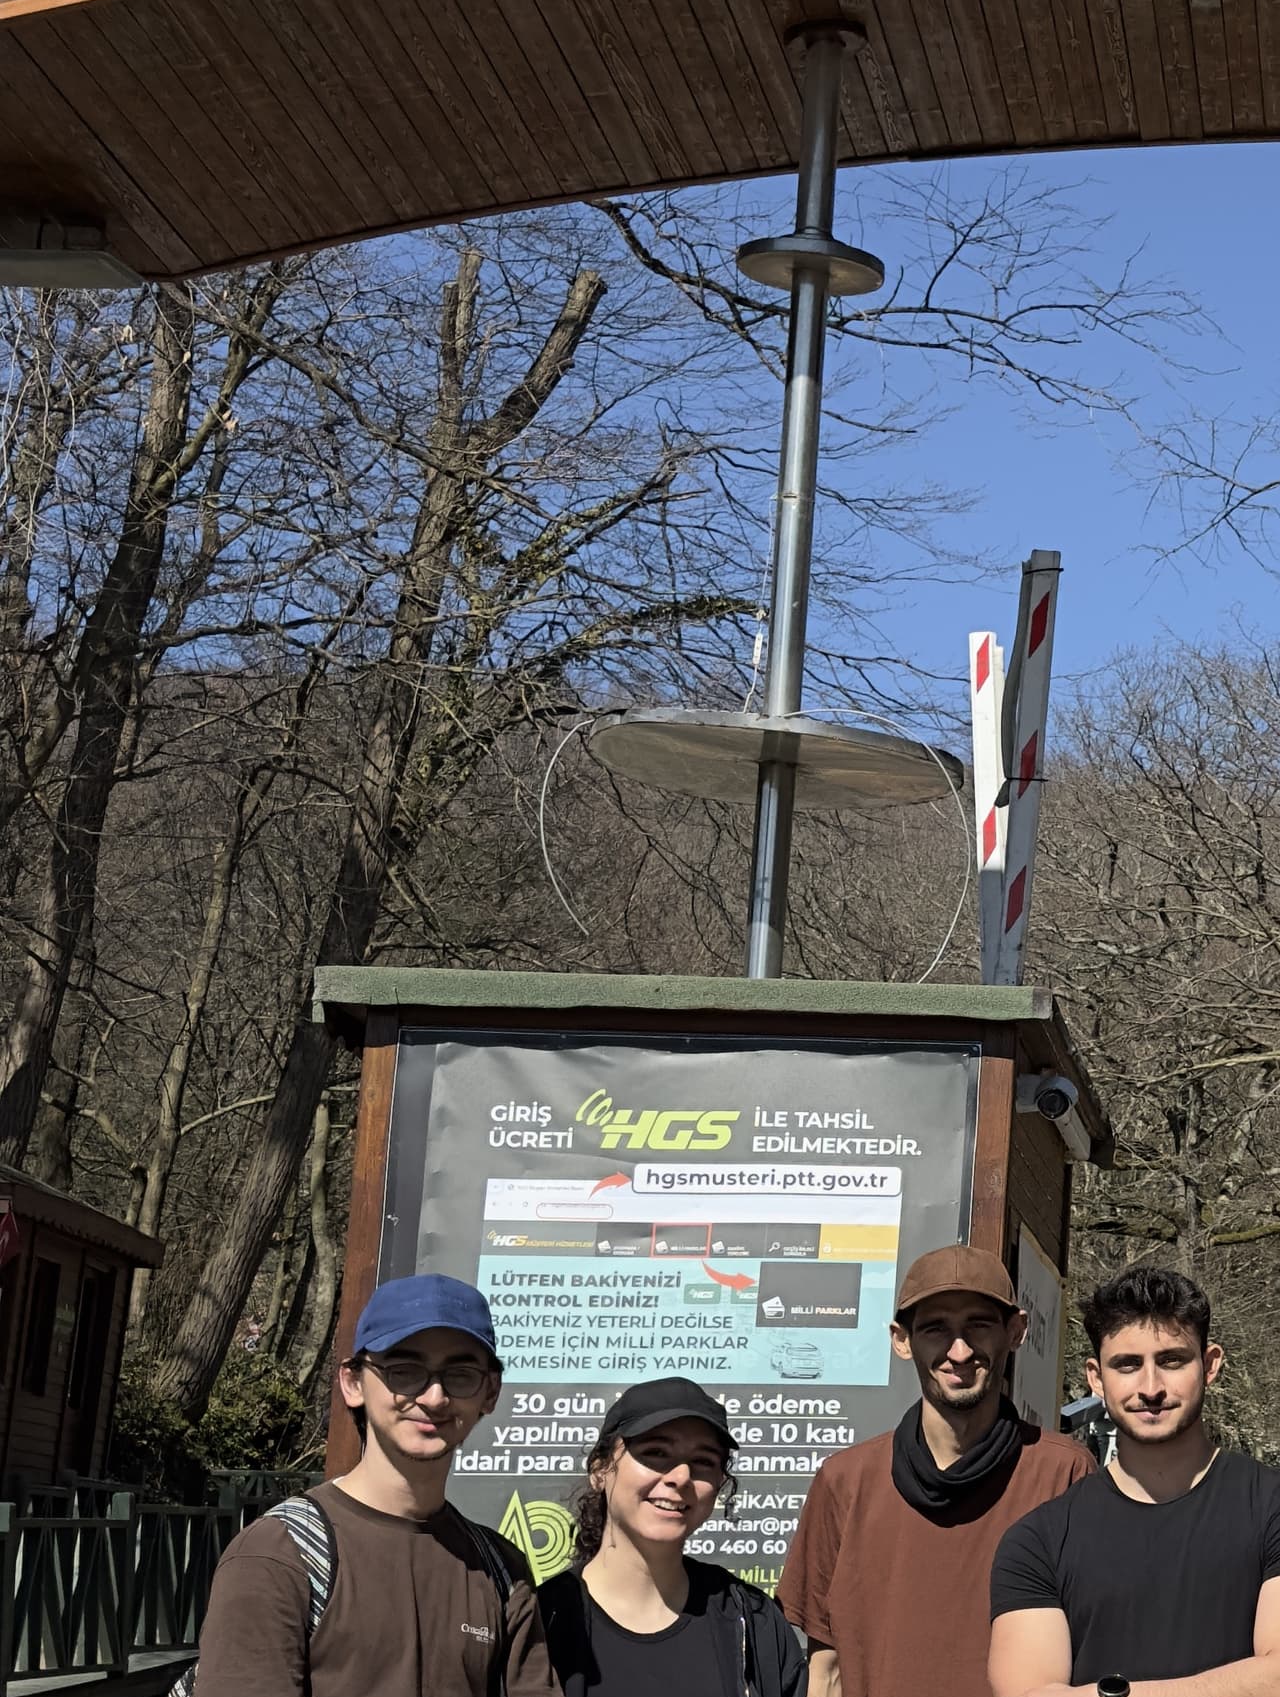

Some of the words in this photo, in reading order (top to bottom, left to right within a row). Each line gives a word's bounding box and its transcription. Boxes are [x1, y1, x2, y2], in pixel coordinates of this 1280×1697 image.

[490, 1101, 552, 1127] GİRİŞ
[753, 1106, 788, 1128] İLE
[793, 1108, 874, 1130] TAHSİL
[489, 1127, 574, 1149] ÜCRETİ
[600, 1109, 741, 1150] HGS
[752, 1131, 922, 1156] EDİLMEKTEDİR.
[646, 1168, 888, 1191] hgsmusteri.ptt.gov.tr
[493, 1234, 528, 1248] HGS
[490, 1270, 566, 1288] LÜTFEN
[570, 1270, 682, 1289] BAKİYENİZİ
[489, 1293, 582, 1308] KONTROL
[588, 1292, 660, 1309] EDİNİZ!
[815, 1306, 857, 1316] PARKLAR
[586, 1312, 656, 1329] YETERLİ
[660, 1311, 733, 1330] DEĞİLSE
[561, 1332, 599, 1352] İÇİN
[661, 1335, 749, 1350] PARKLAR
[598, 1353, 647, 1373] GİRİŞ
[652, 1355, 732, 1370] YAPINIZ.
[512, 1393, 546, 1414] 30
[553, 1392, 606, 1417] gün
[748, 1394, 841, 1415] ödeme
[770, 1423, 798, 1444] 10
[806, 1422, 855, 1444] katı
[454, 1449, 511, 1472] idari
[517, 1454, 574, 1475] para
[719, 1539, 758, 1555] 460
[762, 1539, 787, 1555] 60
